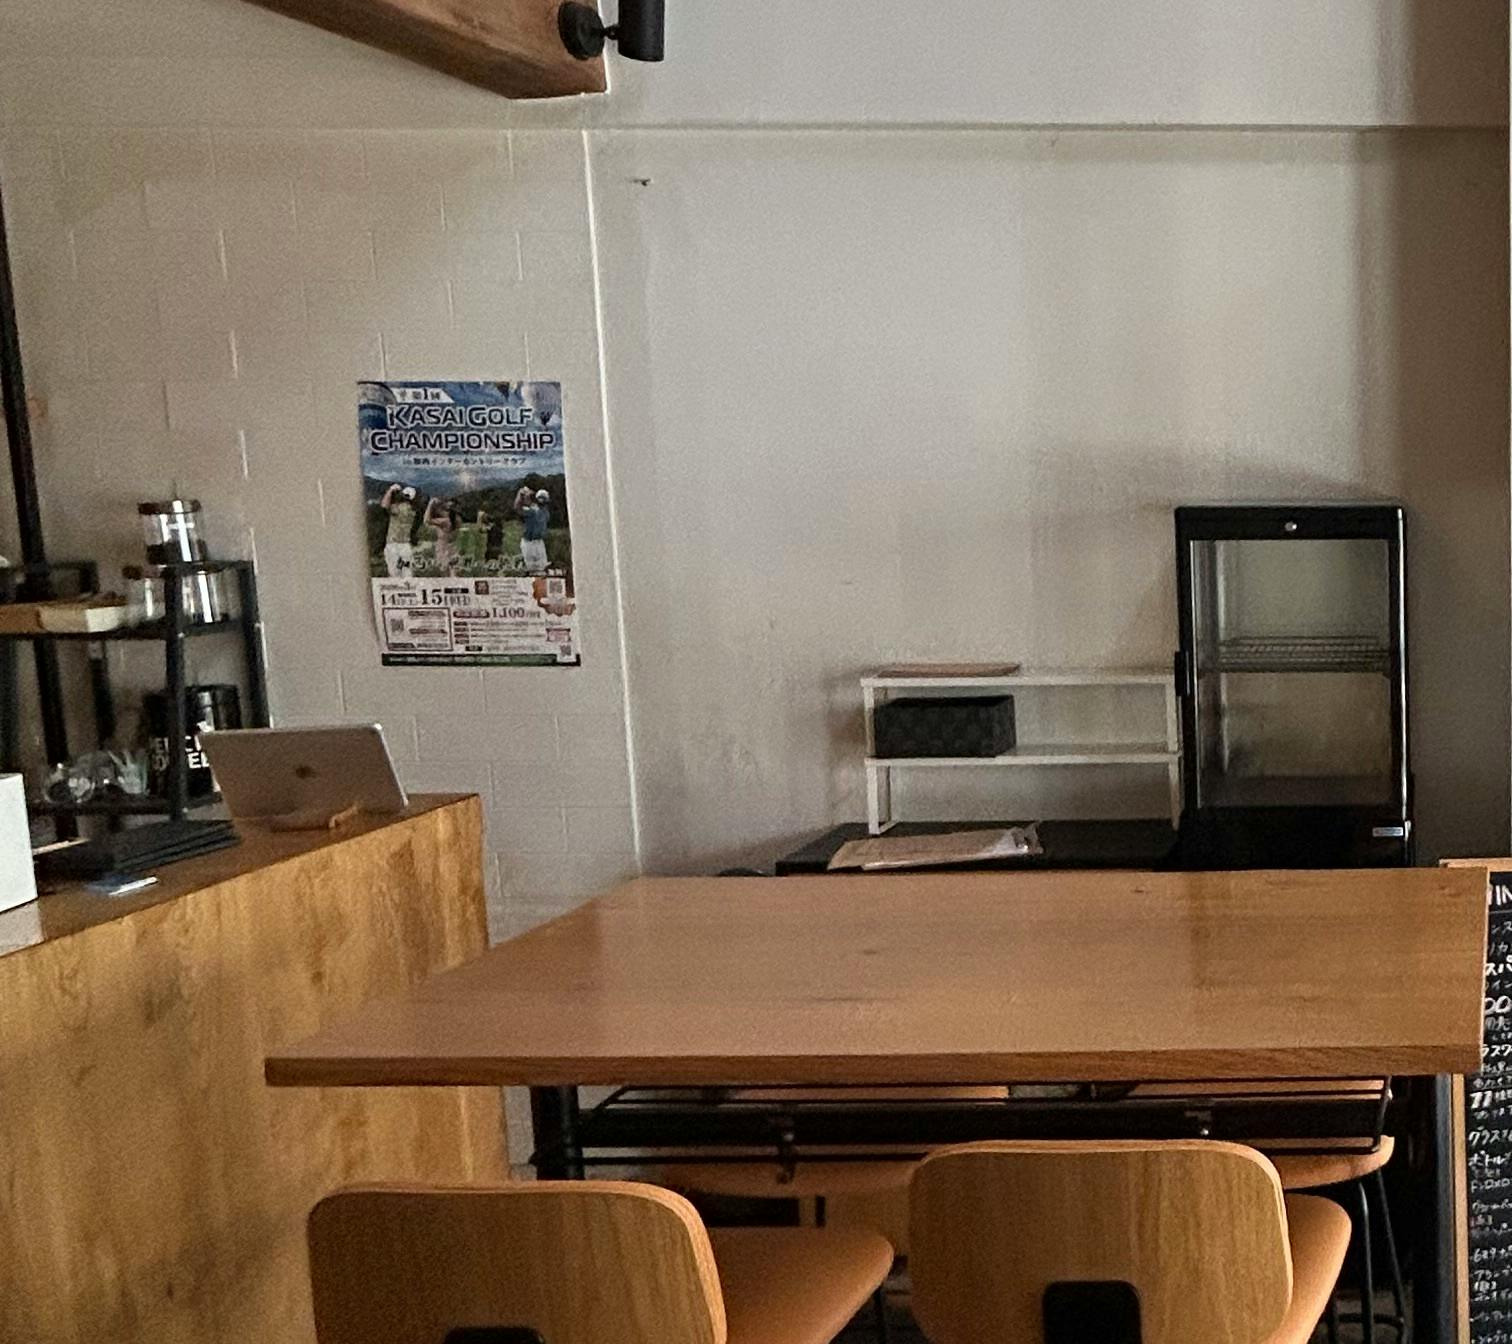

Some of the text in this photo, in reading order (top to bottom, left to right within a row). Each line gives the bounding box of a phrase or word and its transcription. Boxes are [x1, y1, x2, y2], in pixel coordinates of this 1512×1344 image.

[388, 406, 533, 428] KASAI GOLF
[370, 430, 556, 452] CHAMPIONSHIP
[421, 588, 442, 606] 15
